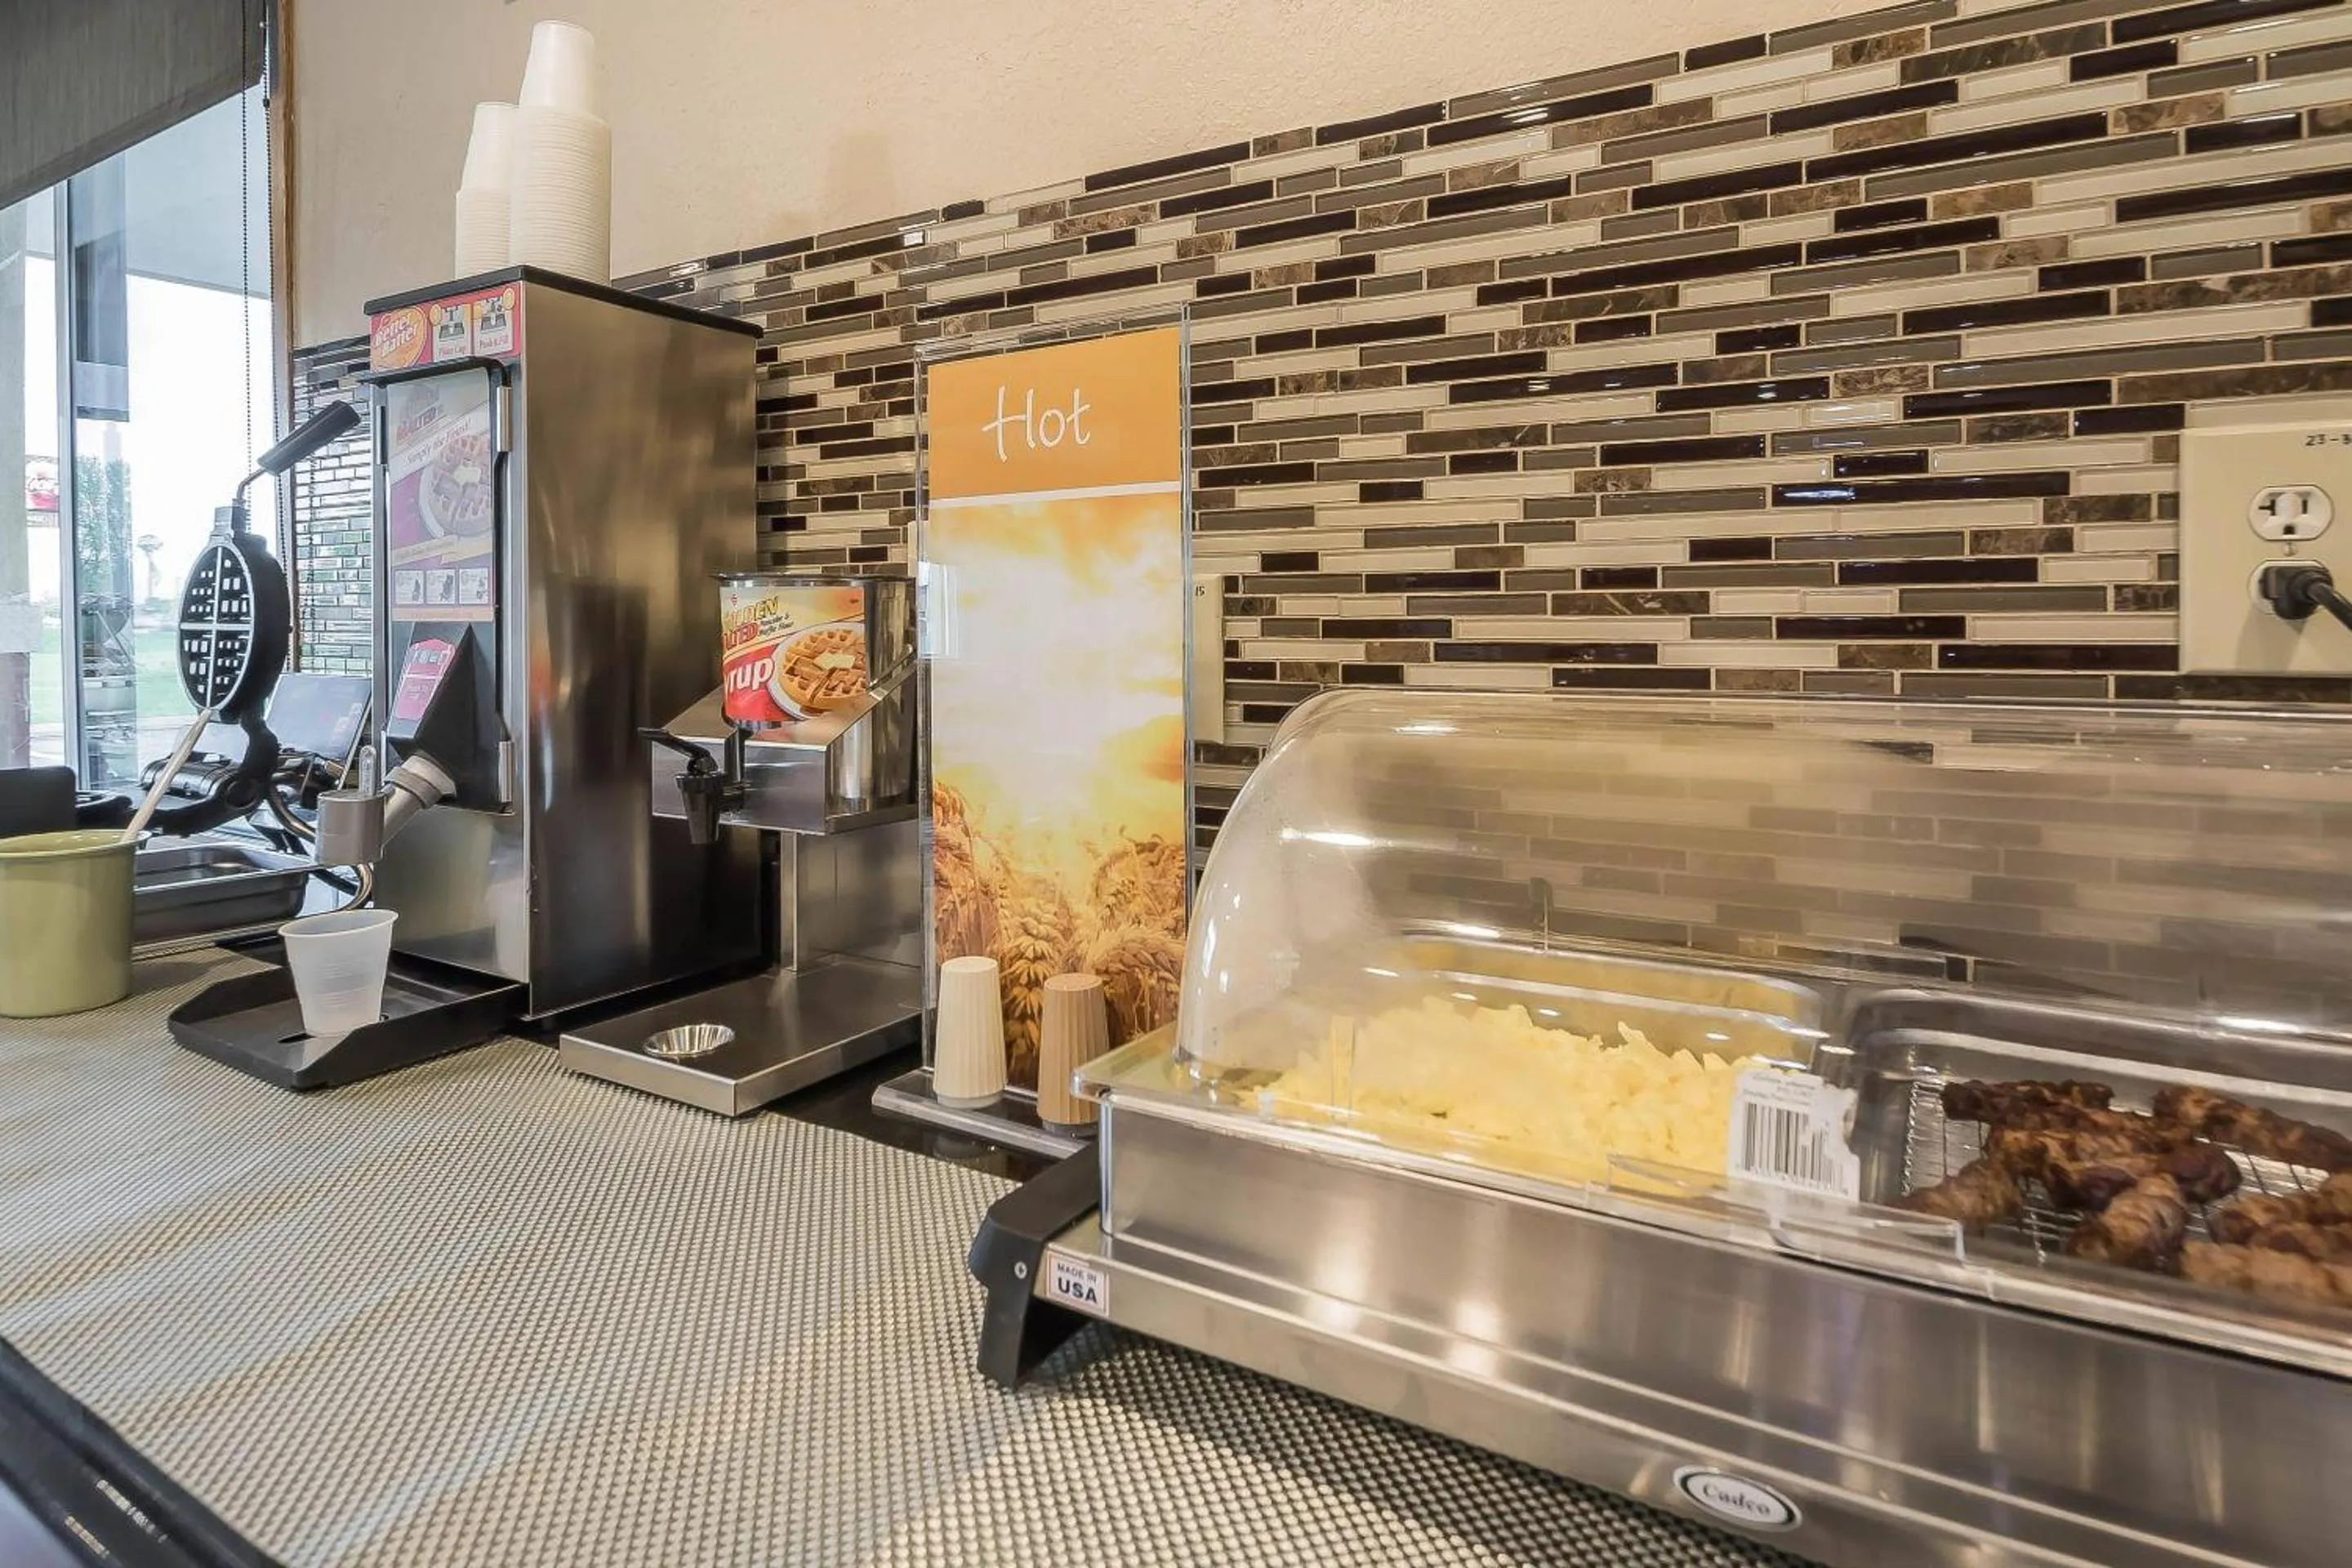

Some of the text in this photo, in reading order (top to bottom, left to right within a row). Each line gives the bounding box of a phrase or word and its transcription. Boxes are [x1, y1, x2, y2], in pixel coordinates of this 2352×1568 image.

[981, 385, 1091, 462] Hot
[1195, 586, 1205, 596] 15
[1058, 1263, 1097, 1283] MADE IN
[1058, 1276, 1098, 1303] USA
[1703, 1482, 1771, 1516] Cadco
